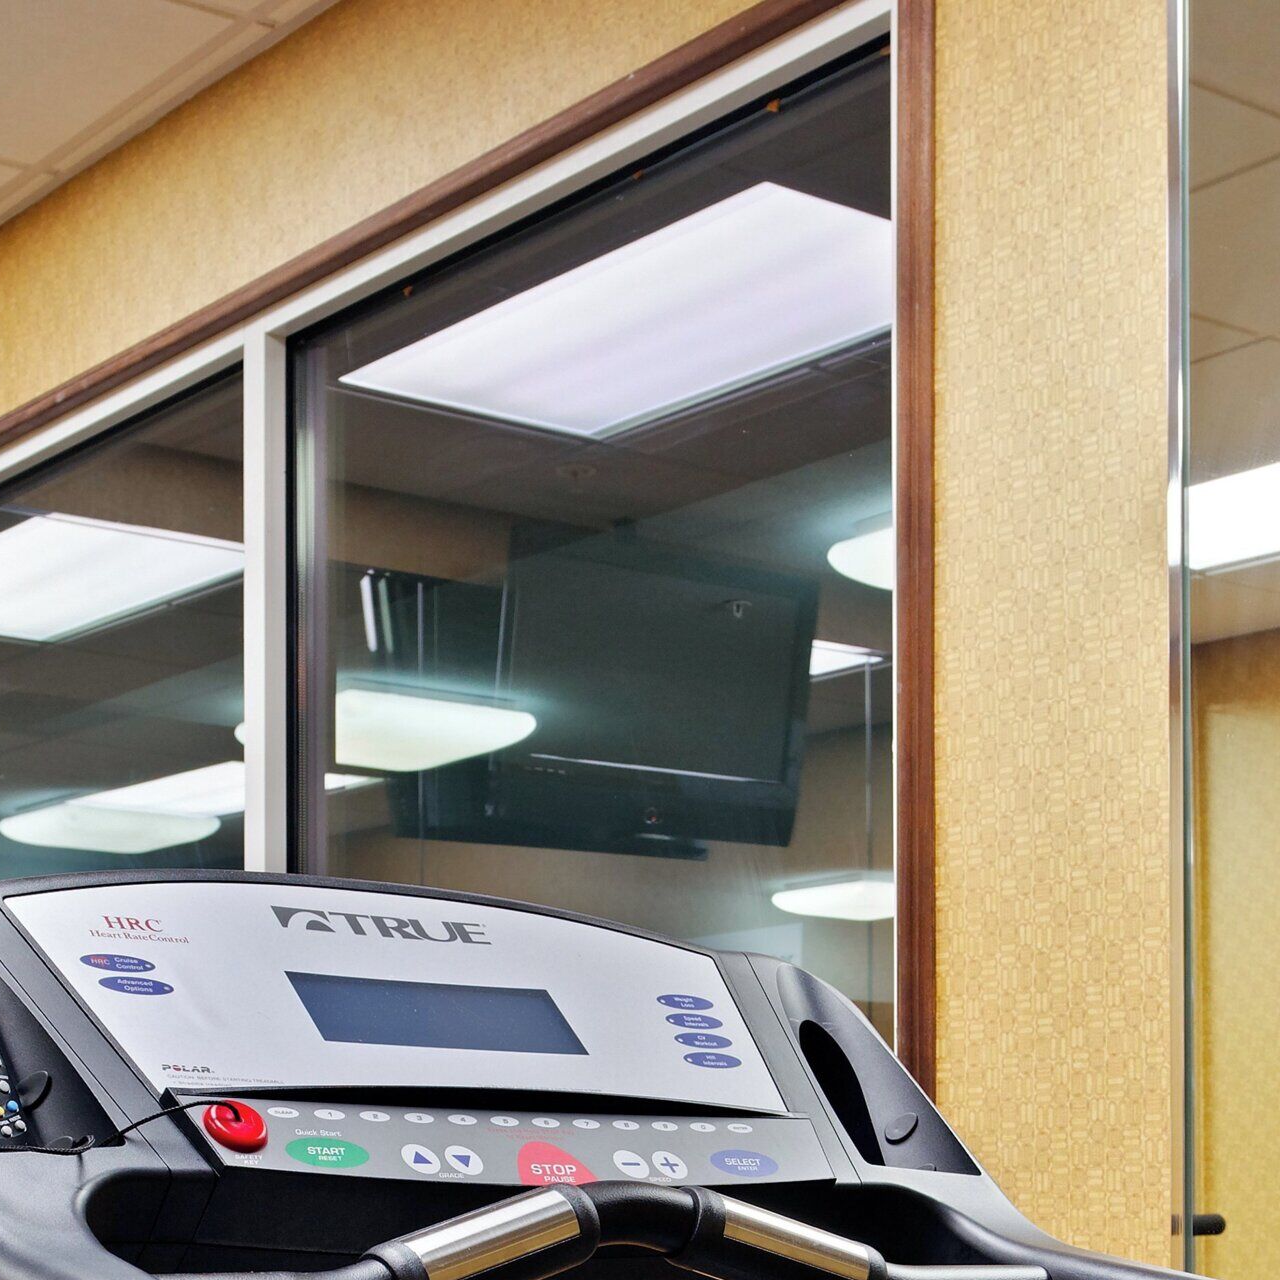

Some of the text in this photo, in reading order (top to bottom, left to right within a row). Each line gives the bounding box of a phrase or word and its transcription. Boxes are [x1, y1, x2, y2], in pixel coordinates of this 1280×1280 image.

[102, 915, 164, 932] HRC
[328, 910, 492, 945] TRUE
[89, 929, 189, 944] Heart Rate Control
[116, 963, 144, 971] Control
[117, 979, 153, 987] Advanced
[124, 985, 153, 993] Options
[162, 1064, 211, 1074] POLAR
[295, 1128, 342, 1137] Quick Start
[307, 1146, 345, 1156] START
[724, 1158, 761, 1167] SELECT
[530, 1163, 577, 1176] STOP
[439, 1172, 465, 1180] GRADE
[544, 1175, 577, 1183] PAUSE
